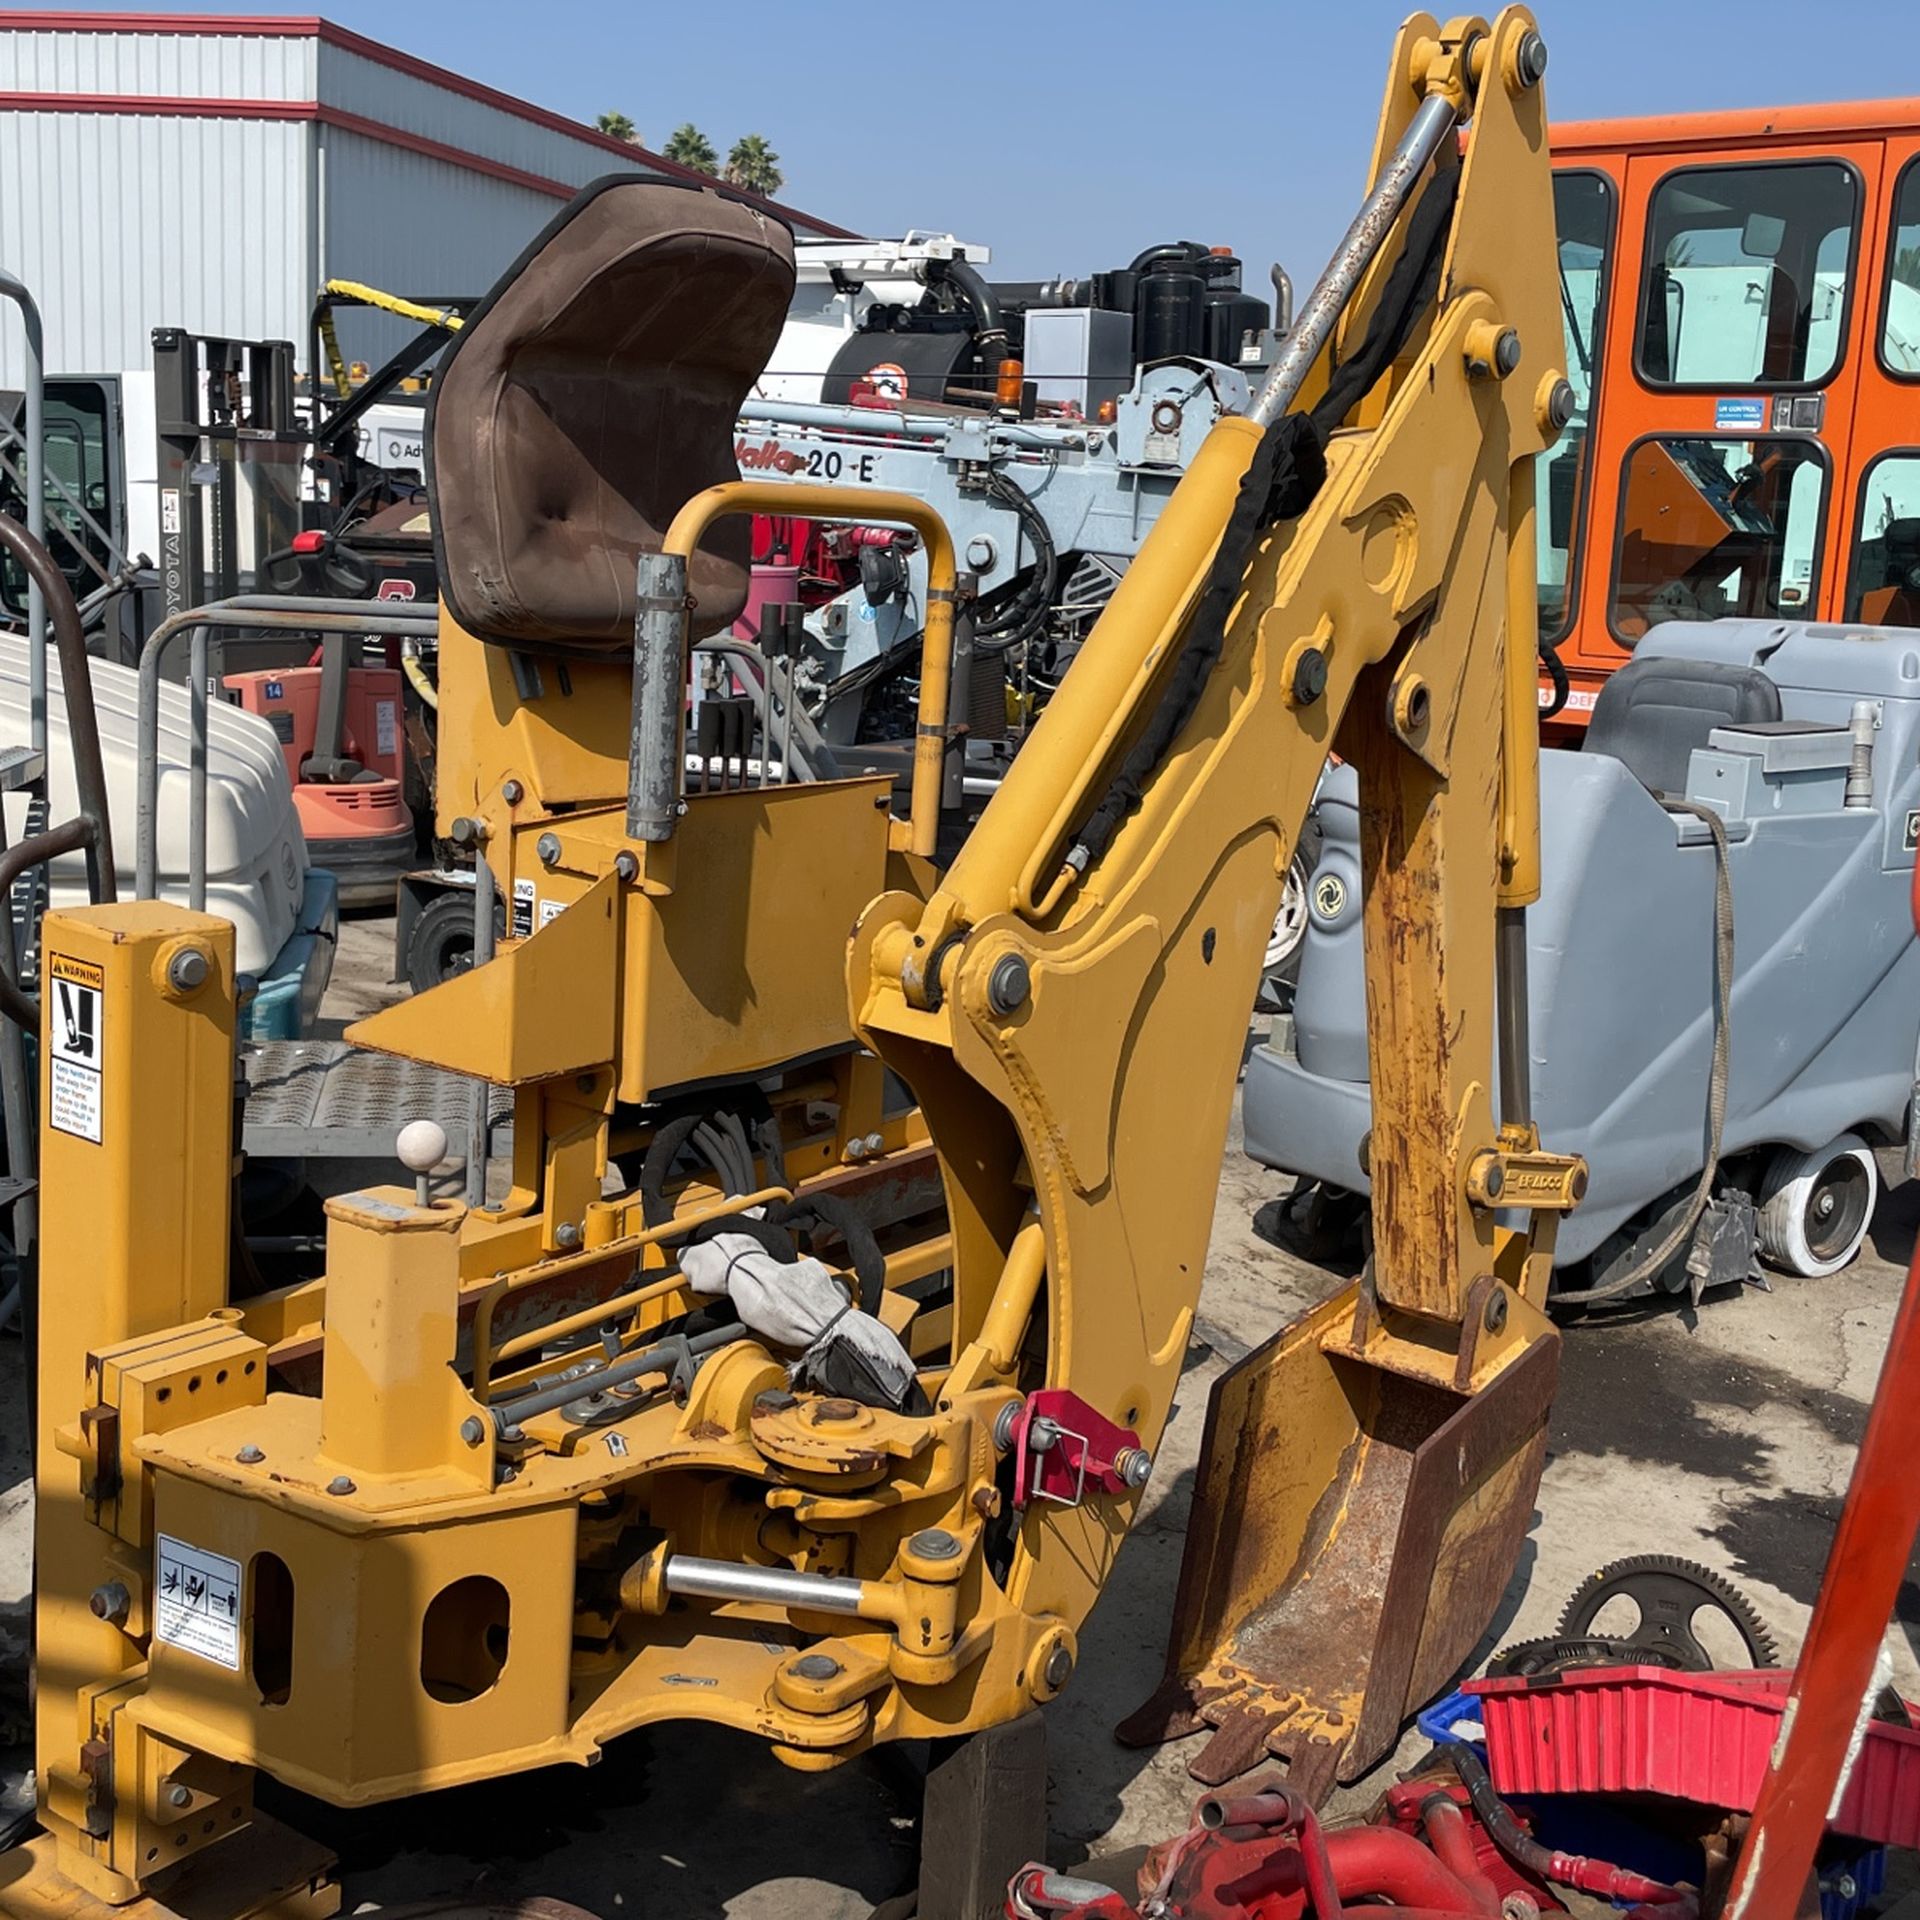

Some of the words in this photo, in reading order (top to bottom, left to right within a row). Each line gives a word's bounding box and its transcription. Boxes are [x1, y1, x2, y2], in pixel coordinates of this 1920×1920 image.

[404, 444, 424, 457] Ad
[165, 535, 181, 619] OYOTA
[268, 684, 281, 697] 14
[64, 963, 100, 983] WARNING
